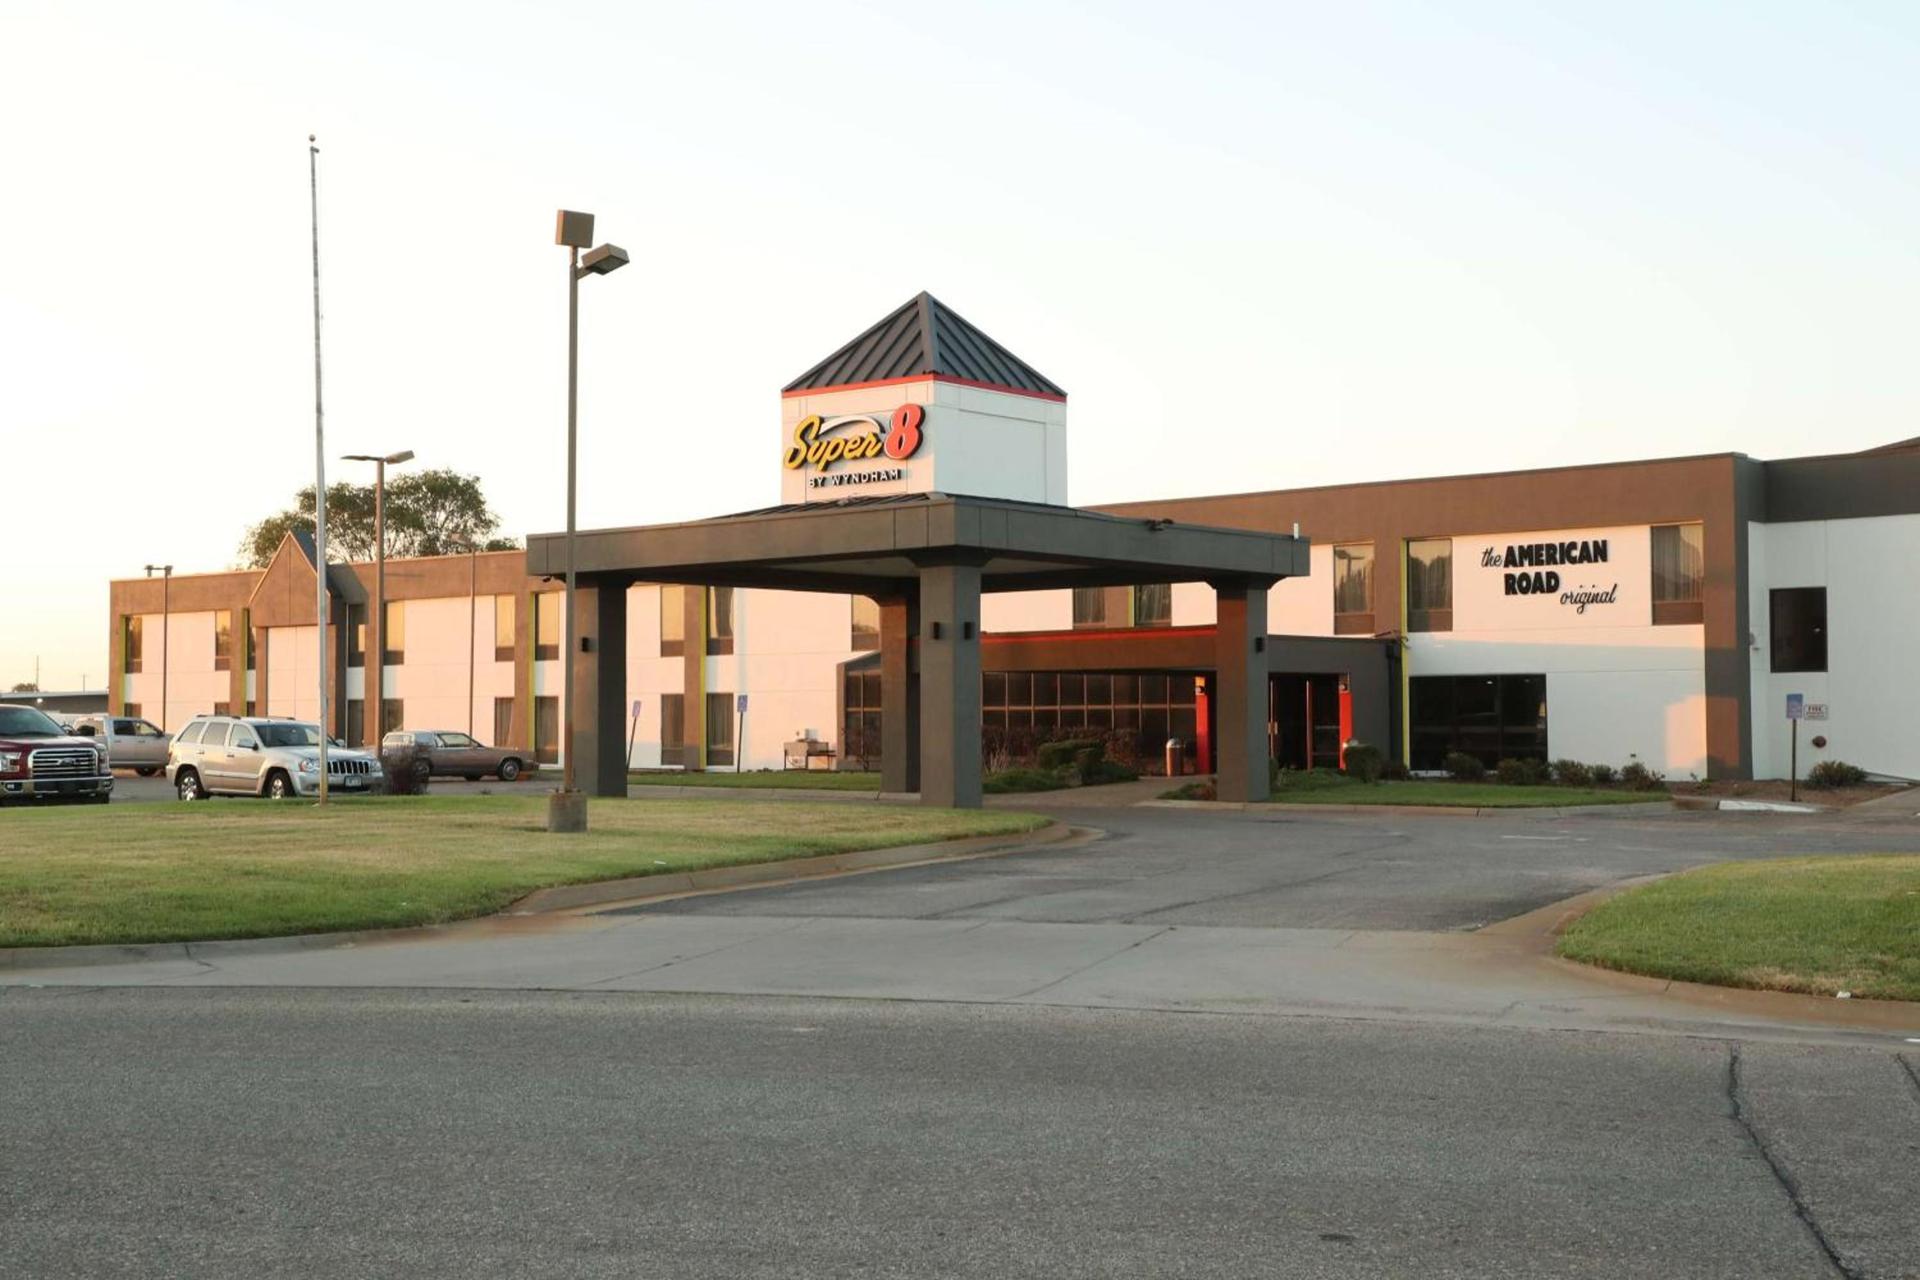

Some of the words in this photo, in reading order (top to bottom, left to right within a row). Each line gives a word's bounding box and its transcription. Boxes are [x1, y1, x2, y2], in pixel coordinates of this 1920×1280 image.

[784, 414, 883, 472] Super
[884, 403, 926, 460] 8
[809, 476, 826, 488] BY
[831, 469, 902, 486] WYNDHAM
[1480, 547, 1502, 568] the
[1503, 539, 1608, 568] AMERICAN
[1504, 571, 1560, 596] ROAD
[1560, 583, 1618, 614] original
